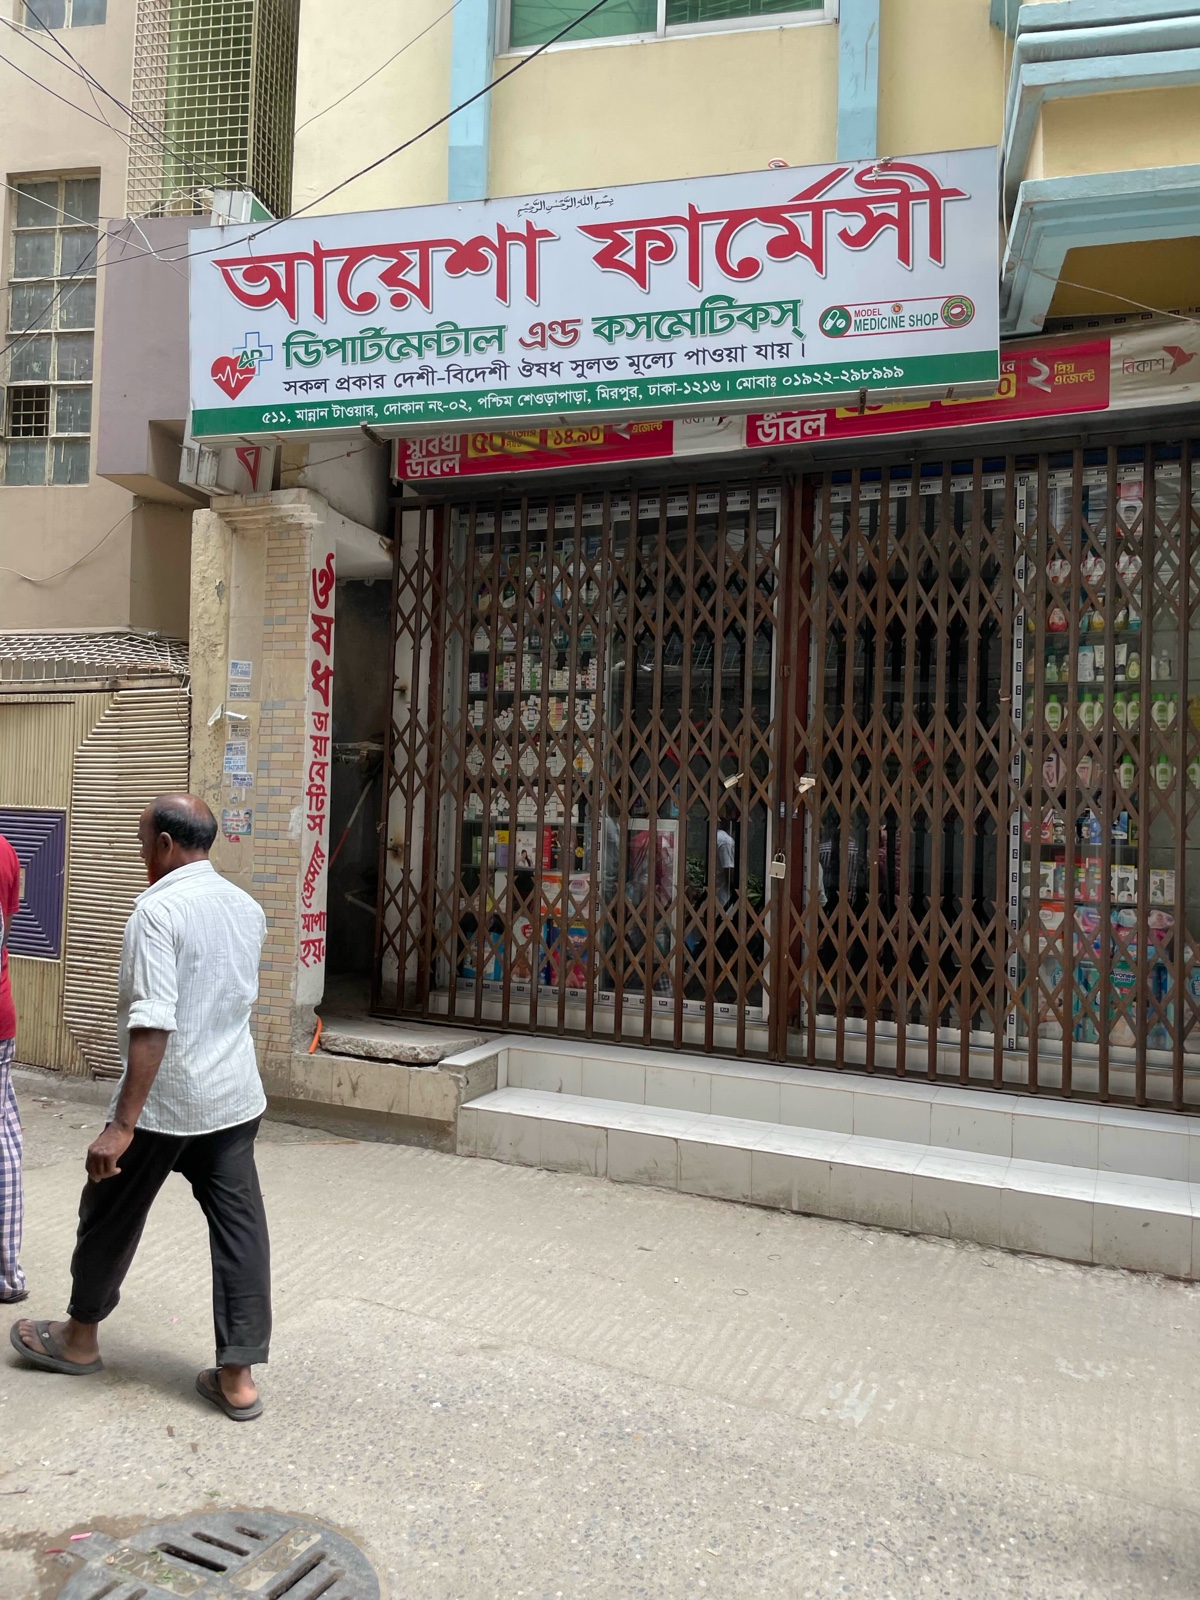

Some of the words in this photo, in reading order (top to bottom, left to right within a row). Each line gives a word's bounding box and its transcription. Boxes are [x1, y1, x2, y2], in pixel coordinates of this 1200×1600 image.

[211, 219, 560, 324] আয়েশা
[576, 162, 971, 294] ফার্মেসী
[854, 308, 882, 318] MODEL
[854, 315, 906, 332] MEDICINE
[908, 312, 939, 328] SHOP
[282, 321, 508, 369] ডিপার্টমেন্টাল
[591, 294, 806, 342] কসমেটিকস্
[283, 378, 330, 396] সকল
[335, 373, 387, 393] প্রকার
[393, 359, 511, 389] দেশী-বিদেশী
[518, 358, 564, 379] ঔষধ
[570, 356, 620, 379] সুলভ
[625, 352, 677, 375] মূল্যে
[684, 343, 748, 366] পাওয়া
[1053, 368, 1096, 386] এজেন্টে
[1122, 356, 1166, 375] বিকাশ
[262, 411, 291, 425] ৫১১,
[296, 406, 329, 423] মান্নান
[331, 402, 379, 420] টাওয়ার,
[383, 400, 425, 416] দোকান
[477, 391, 512, 408] পশ্চিম
[517, 387, 592, 407] শেওড়াপাড়া,
[596, 384, 643, 402] মিরপুর,
[781, 365, 905, 387] ০১৯২২-২৯৮৯৯৯
[553, 425, 602, 446] ১৪.৯০
[756, 412, 828, 443] ডাবল
[405, 453, 461, 477] ডাবল
